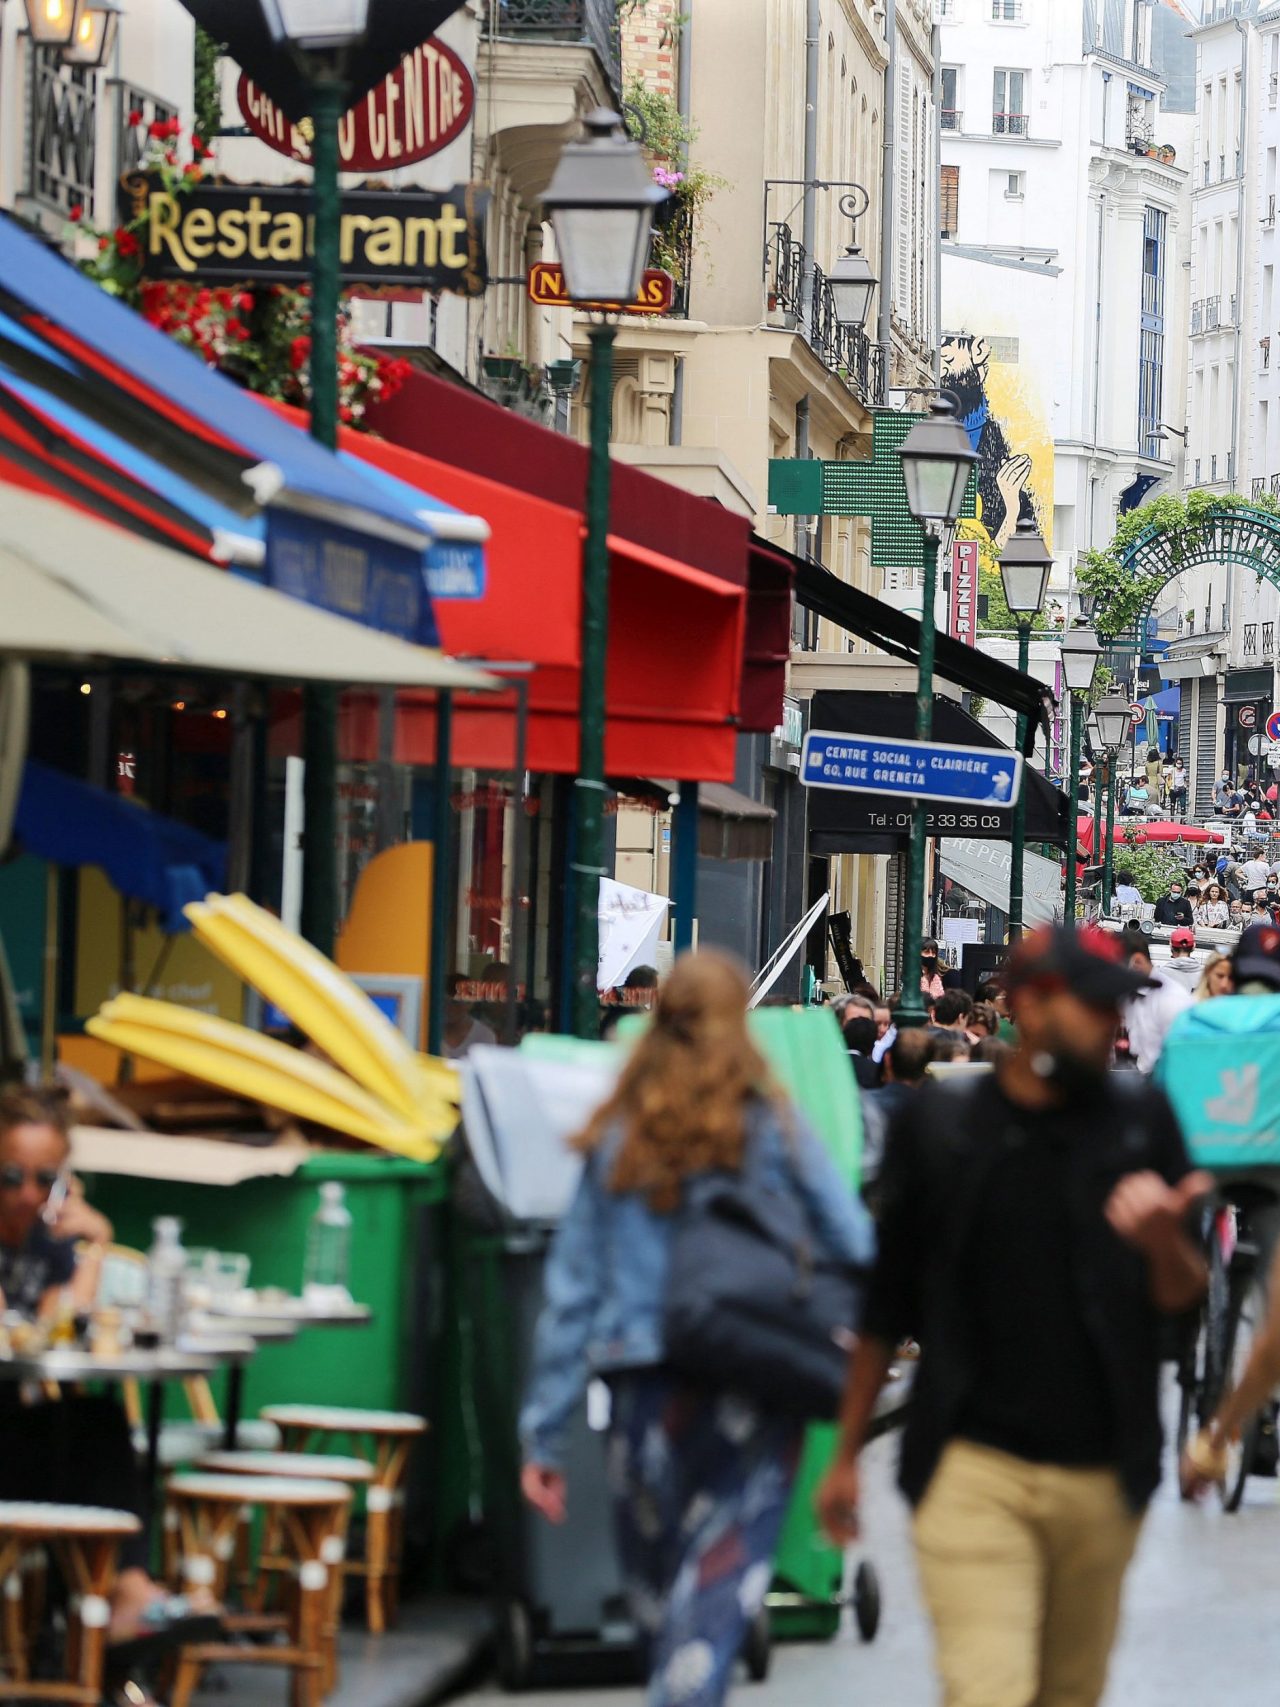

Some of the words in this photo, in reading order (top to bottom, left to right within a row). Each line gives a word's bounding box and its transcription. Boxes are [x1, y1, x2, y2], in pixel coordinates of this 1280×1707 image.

[367, 43, 465, 160] CENTRE
[825, 746, 867, 762] CENTRE
[872, 750, 911, 767] SOCIAL
[844, 765, 867, 780] RUE
[873, 768, 926, 785] GRENETA
[938, 814, 956, 827] 33
[959, 815, 977, 828] 35
[981, 815, 1000, 828] 03
[941, 838, 1033, 879] REPERE
